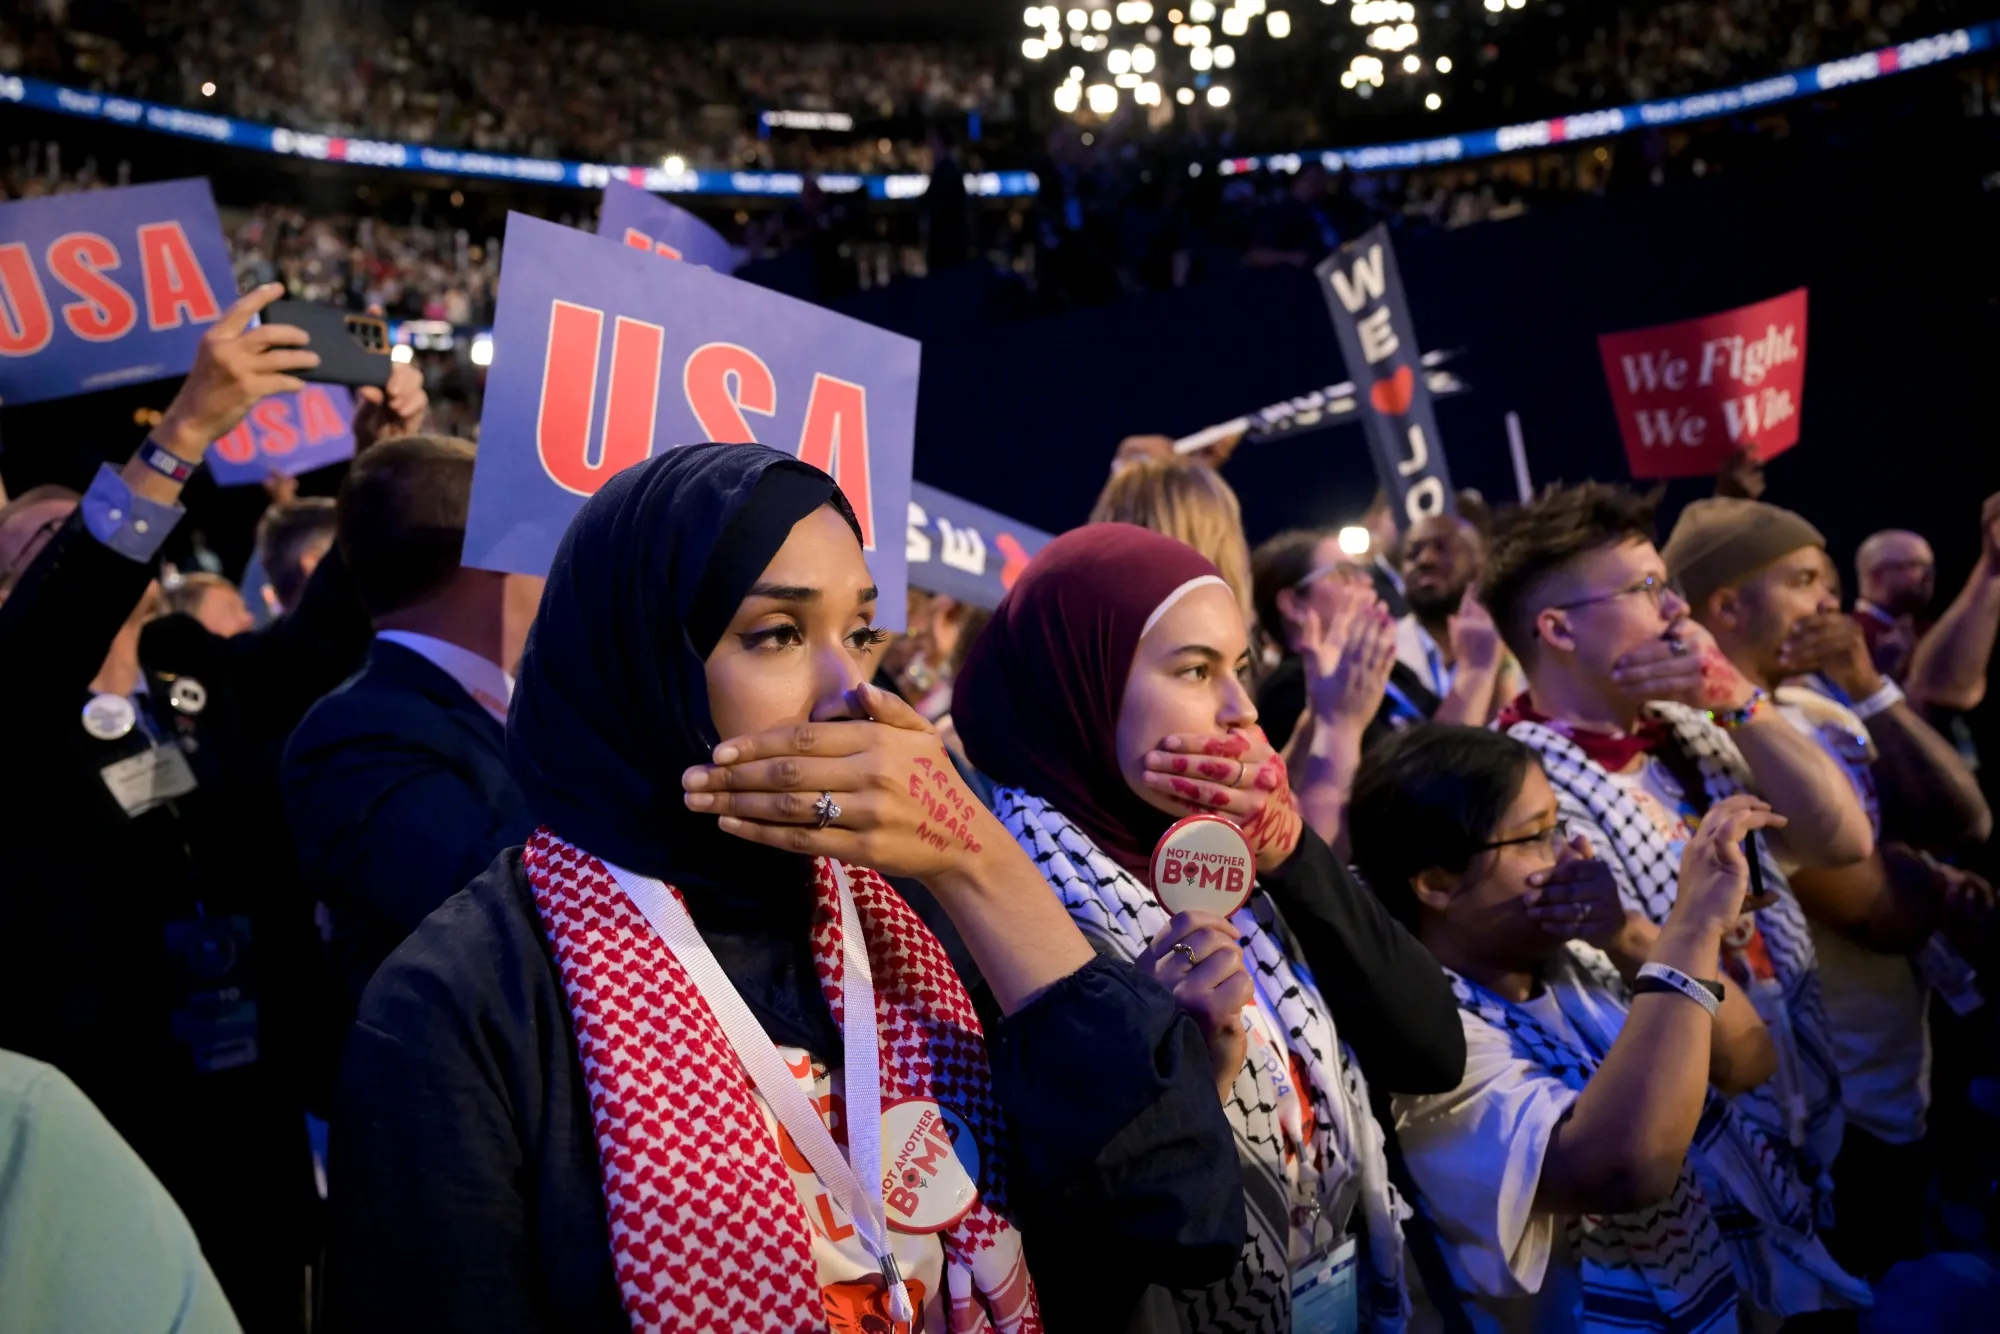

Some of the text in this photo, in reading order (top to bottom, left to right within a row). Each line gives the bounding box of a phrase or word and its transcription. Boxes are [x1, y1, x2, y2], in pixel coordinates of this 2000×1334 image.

[1621, 349, 1688, 394] We
[1635, 406, 1707, 448] We
[909, 772, 982, 853] EMBARGO
[913, 757, 976, 821] ARMS
[1166, 847, 1245, 867] NOT ANOTHER
[894, 1109, 935, 1172] ANOTHER
